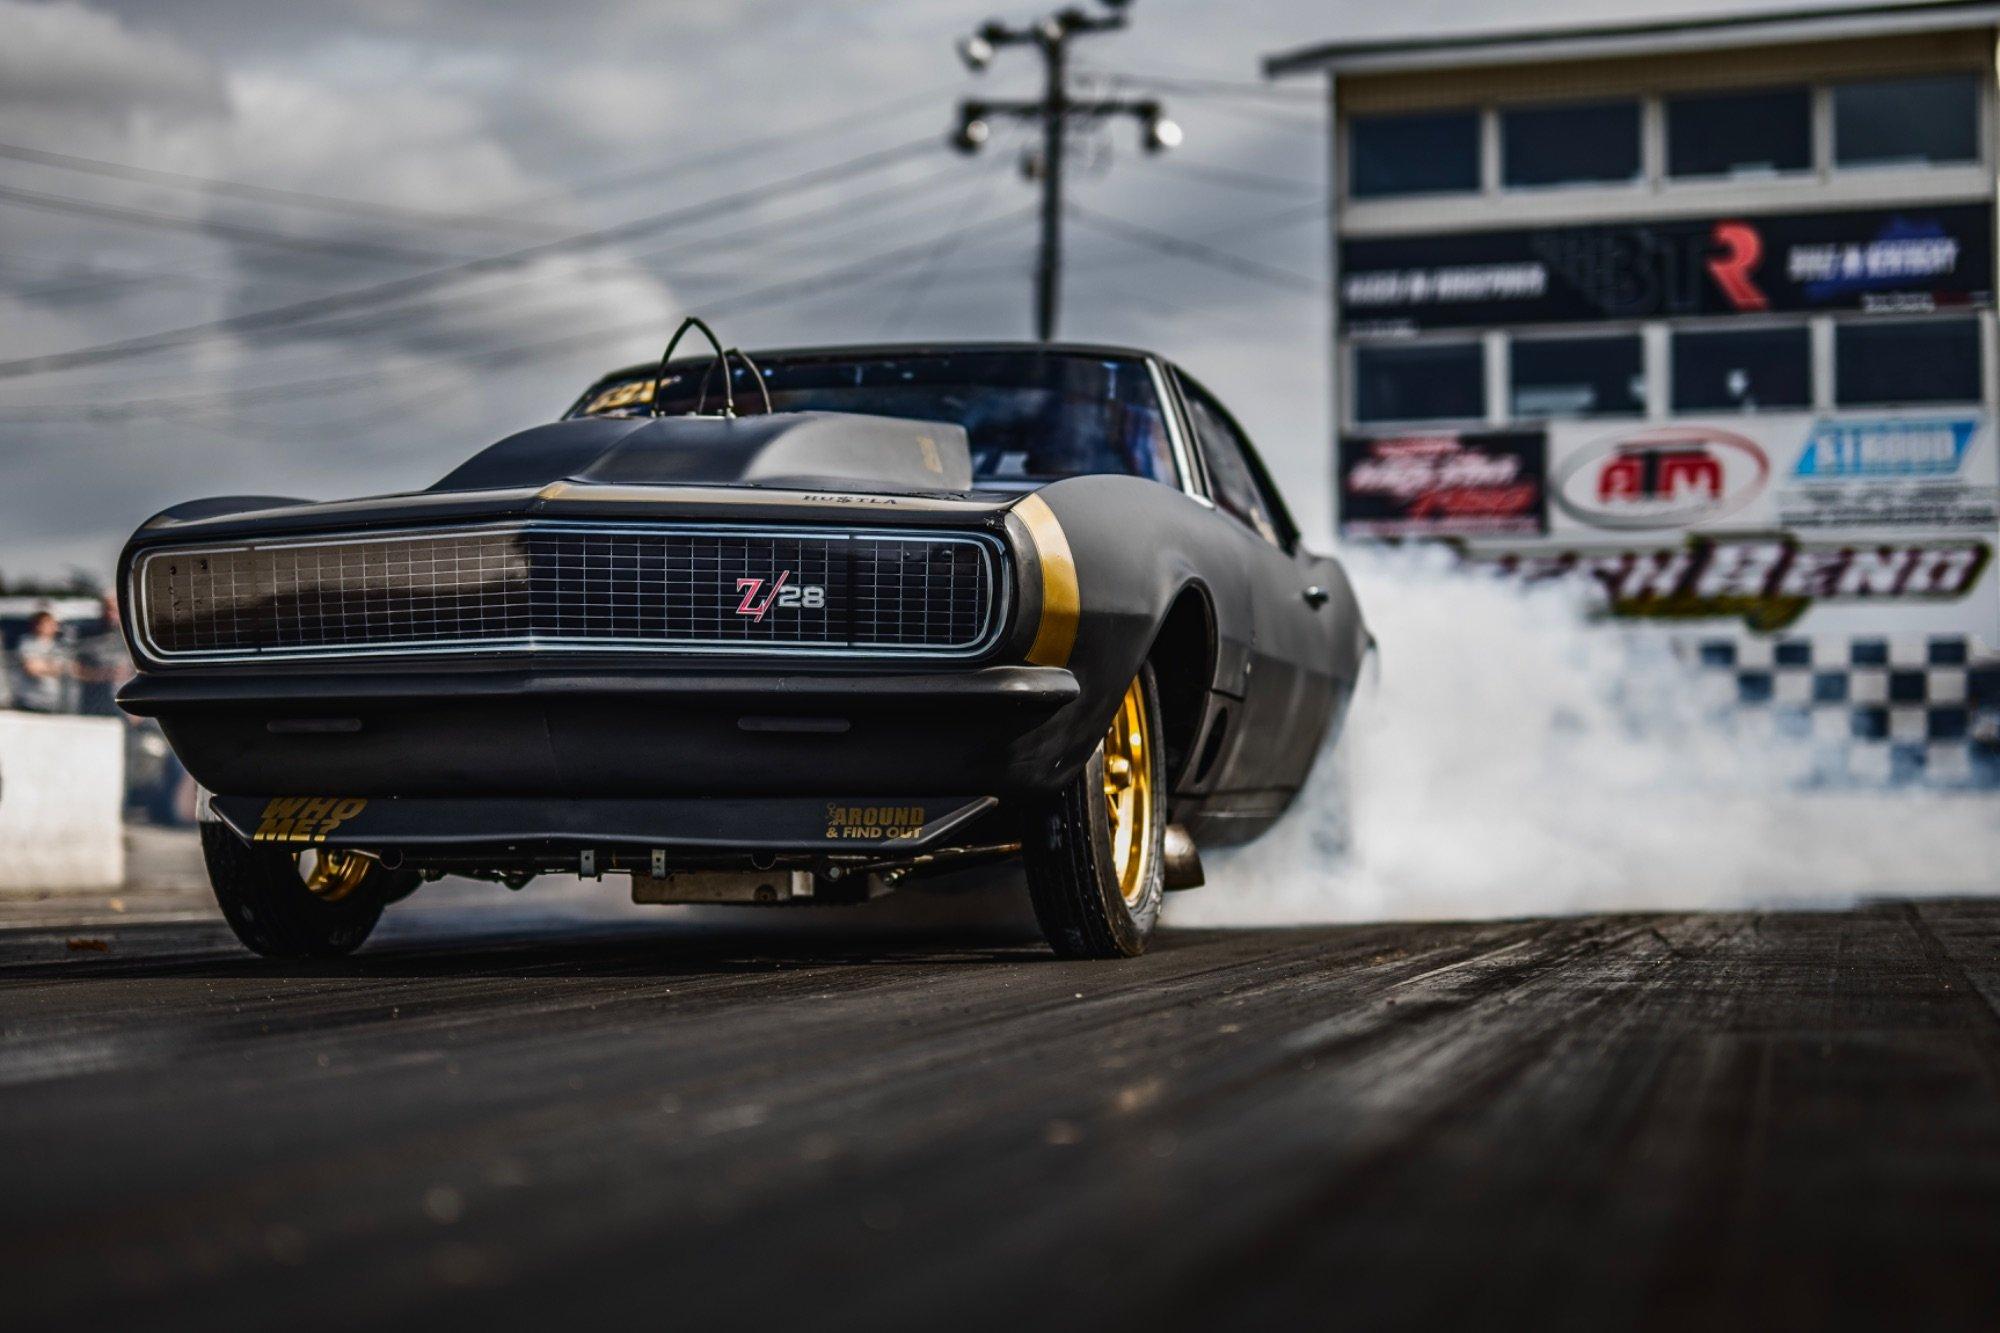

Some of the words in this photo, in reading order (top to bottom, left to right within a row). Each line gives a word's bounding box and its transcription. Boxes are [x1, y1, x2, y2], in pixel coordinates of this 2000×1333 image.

[1597, 441, 1722, 502] ATM
[1694, 540, 1977, 597] BEND
[736, 570, 825, 623] Z/28
[261, 798, 368, 820] WHO
[834, 807, 925, 826] AROUND
[253, 819, 341, 841] ME?
[825, 827, 838, 838] &
[842, 826, 882, 838] FIND
[886, 826, 922, 838] OUT
